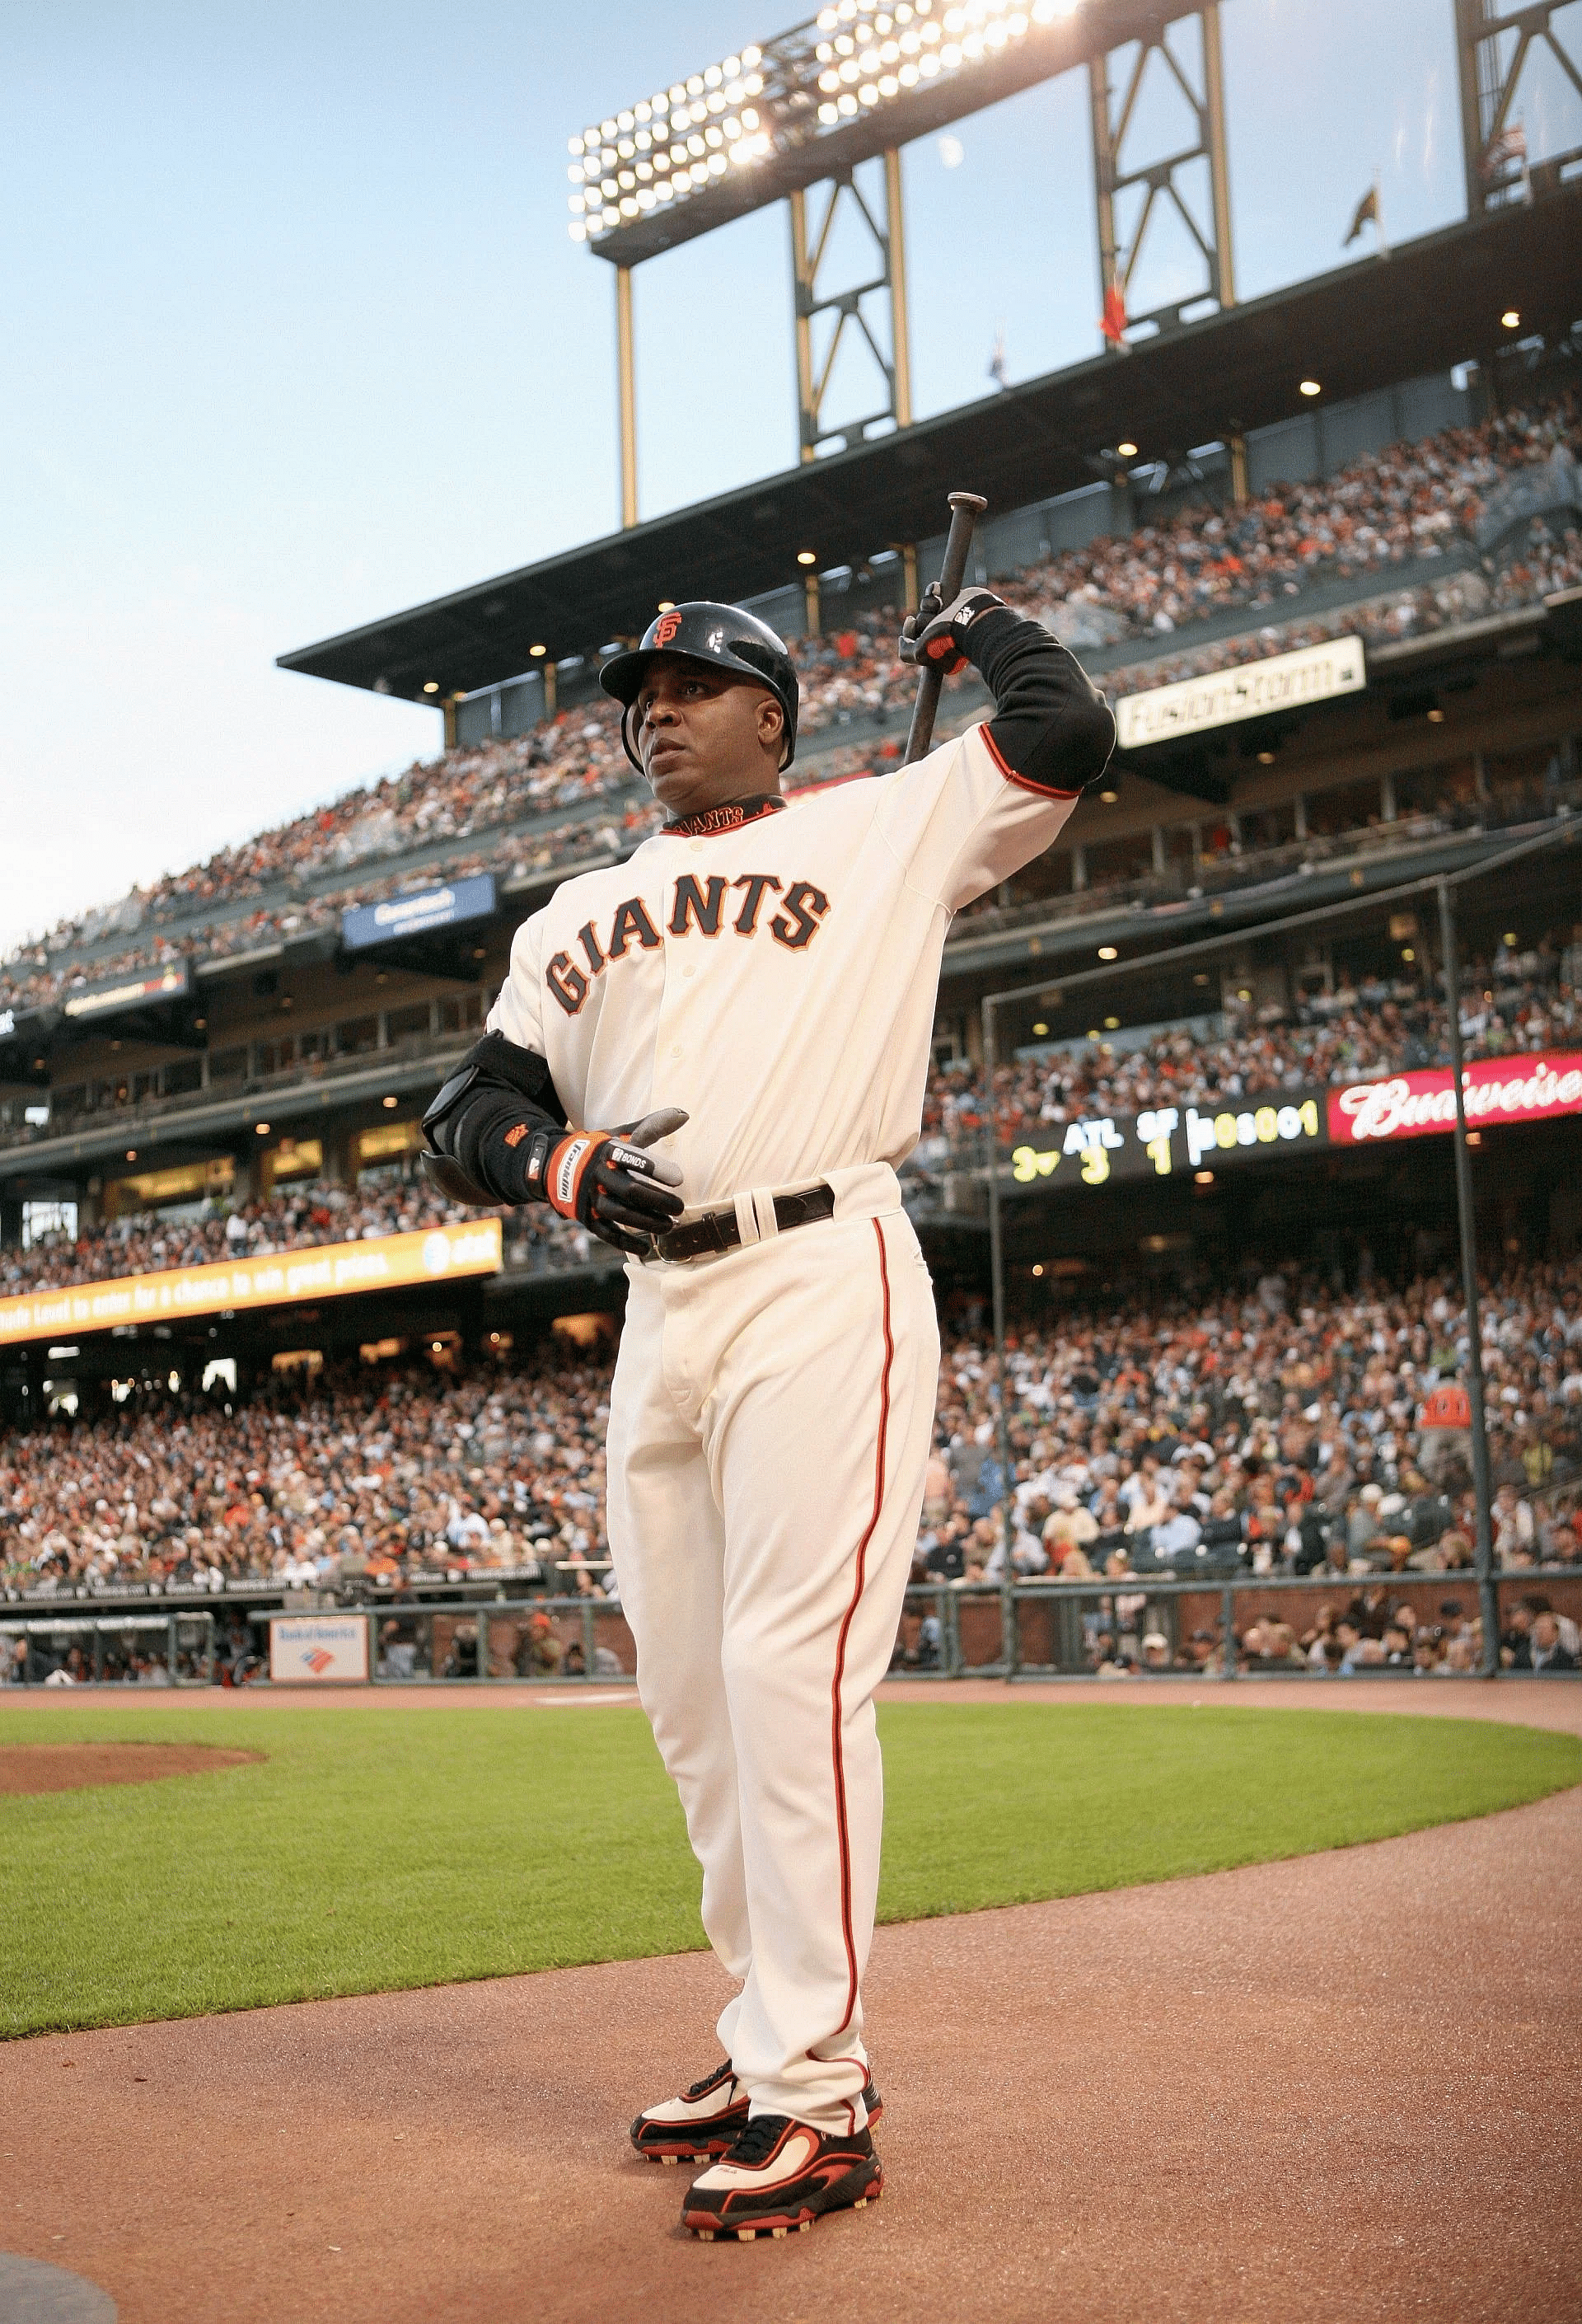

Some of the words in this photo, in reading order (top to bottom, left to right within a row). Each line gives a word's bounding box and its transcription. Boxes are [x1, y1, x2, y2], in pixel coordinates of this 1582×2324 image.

[545, 873, 831, 1017] GIANTS
[1063, 1117, 1125, 1155] ATL
[621, 1153, 648, 1169] BONDS
[1080, 1146, 1110, 1185] 3
[1146, 1136, 1172, 1175] 1
